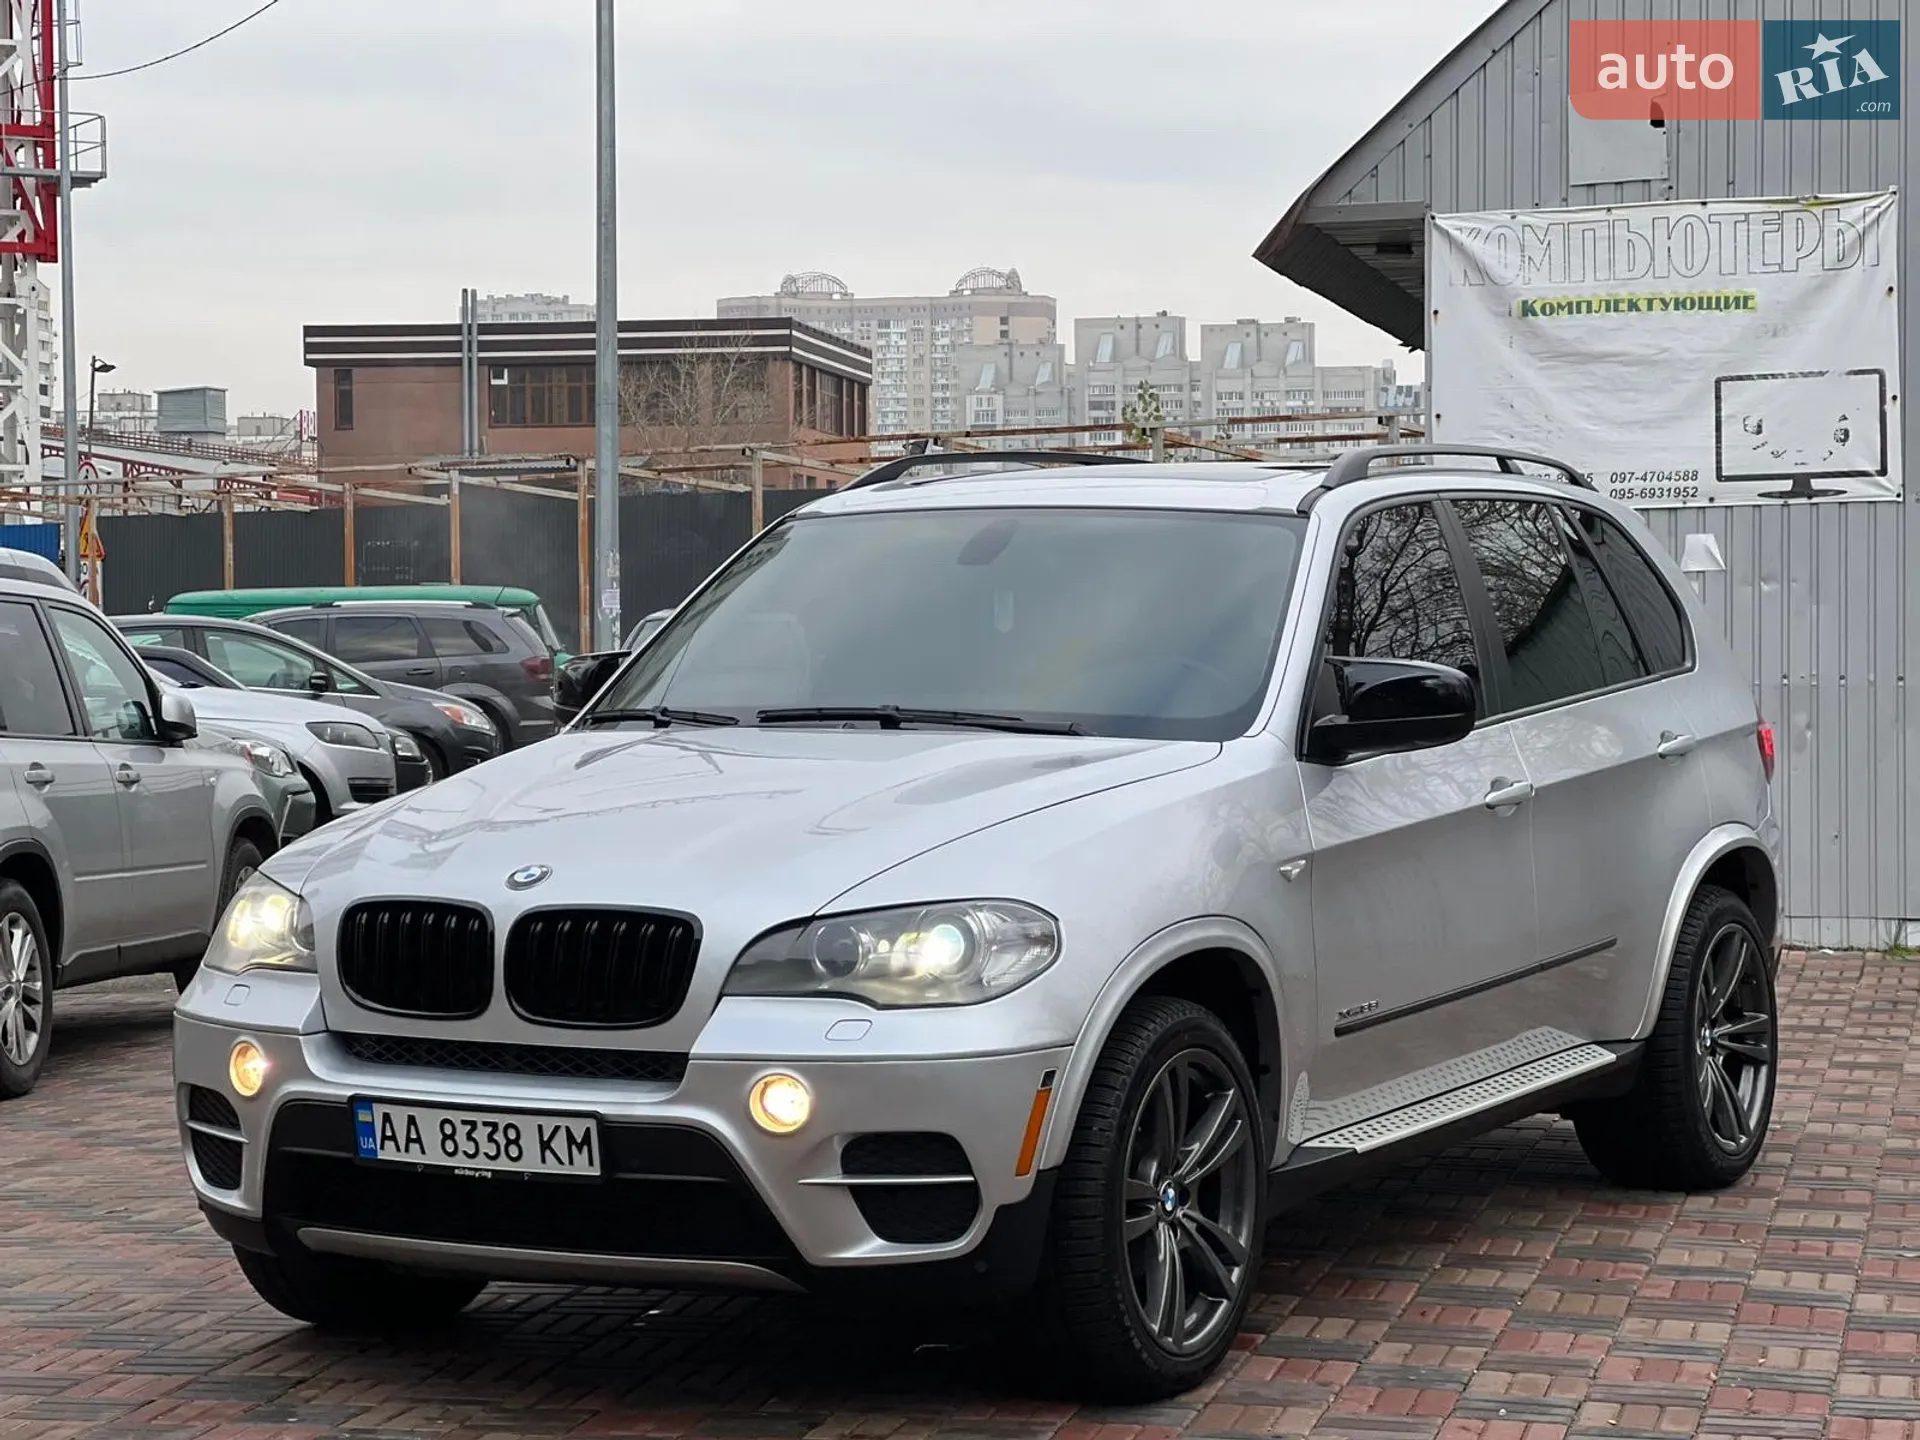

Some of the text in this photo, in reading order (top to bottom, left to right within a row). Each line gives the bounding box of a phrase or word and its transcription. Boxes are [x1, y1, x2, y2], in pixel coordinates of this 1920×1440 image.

[1448, 206, 1882, 287] КОМПЬЮТЕРЫ
[1610, 470, 1699, 484] 097-4704588
[1609, 486, 1699, 500] 095-6931952
[360, 1136, 376, 1150] UA
[379, 1111, 594, 1167] AA 8338 KM
